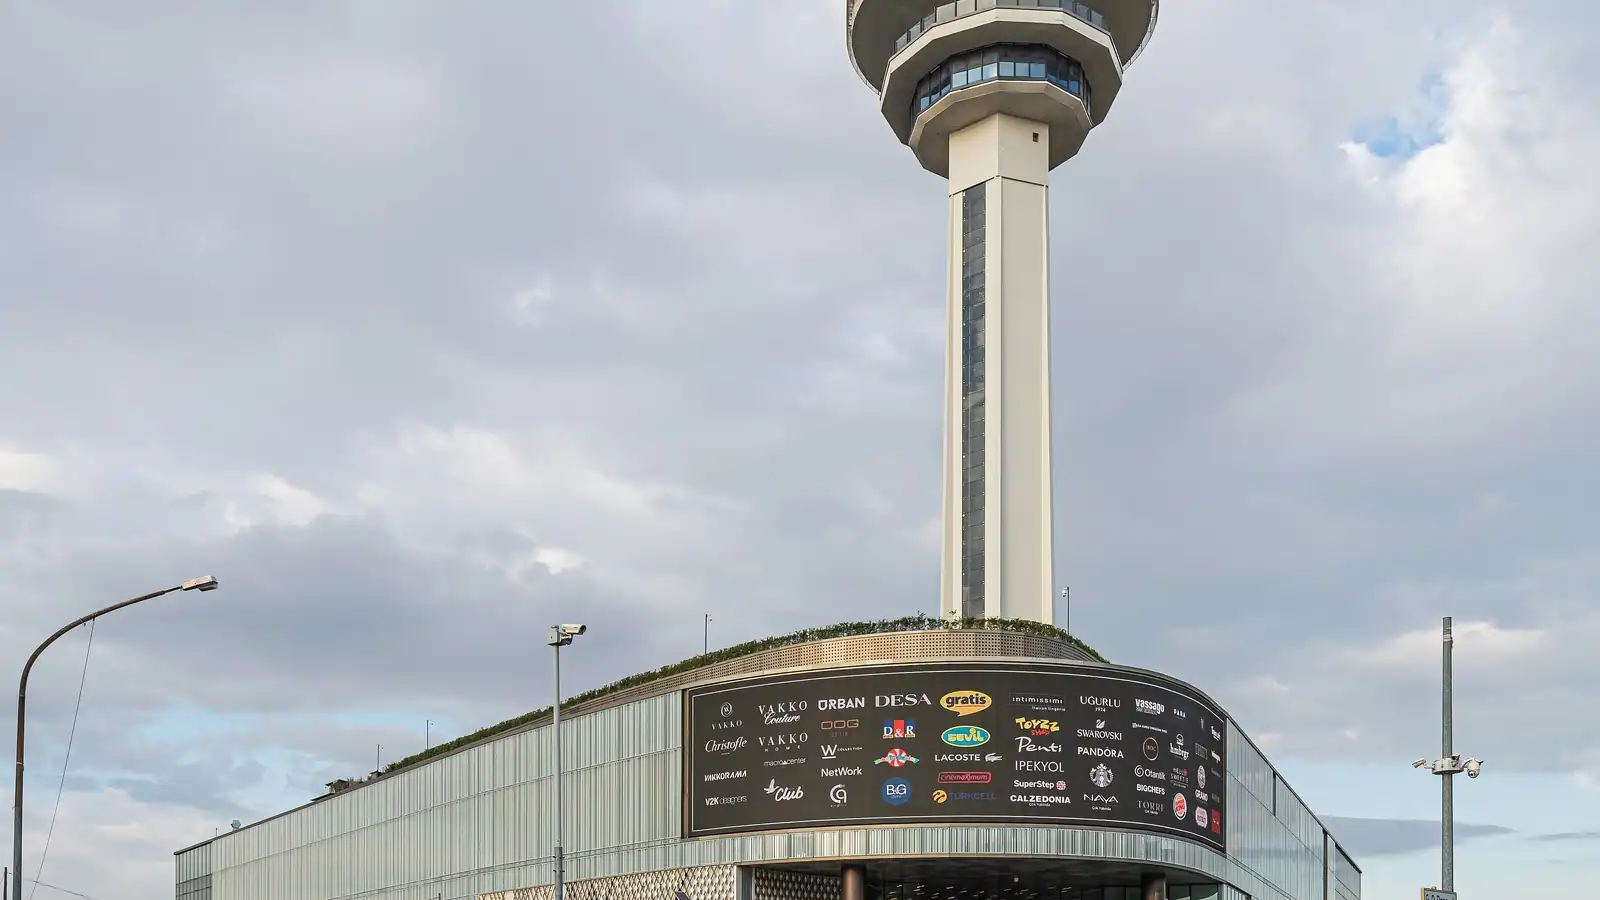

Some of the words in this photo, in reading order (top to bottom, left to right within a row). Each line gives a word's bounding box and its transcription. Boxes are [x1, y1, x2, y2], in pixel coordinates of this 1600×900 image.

[818, 697, 865, 711] URBAN
[875, 693, 932, 708] DESA
[945, 693, 987, 708] gratis
[1012, 695, 1063, 705] intimissimi
[1135, 698, 1165, 715] vassago
[758, 700, 808, 715] VAKKO
[764, 712, 801, 725] Couture
[883, 725, 914, 738] D&R
[1076, 728, 1122, 741] SWAROVSKI
[705, 737, 748, 753] Christofle
[758, 732, 808, 746] VAKKO
[1015, 736, 1062, 753] Penti
[934, 753, 981, 762] LACOSTE
[1077, 746, 1124, 759] PANDORA
[704, 769, 747, 782] VAKKORAMA
[821, 766, 862, 777] NetWork
[1013, 779, 1055, 790] SuperStep
[1136, 784, 1166, 795] BIGCHEFS
[775, 786, 804, 802] Club
[949, 792, 996, 800] TURKCELL
[1010, 794, 1071, 804] CALZEDONIA
[1083, 793, 1119, 804] NAYA
[705, 796, 719, 806] V2K
